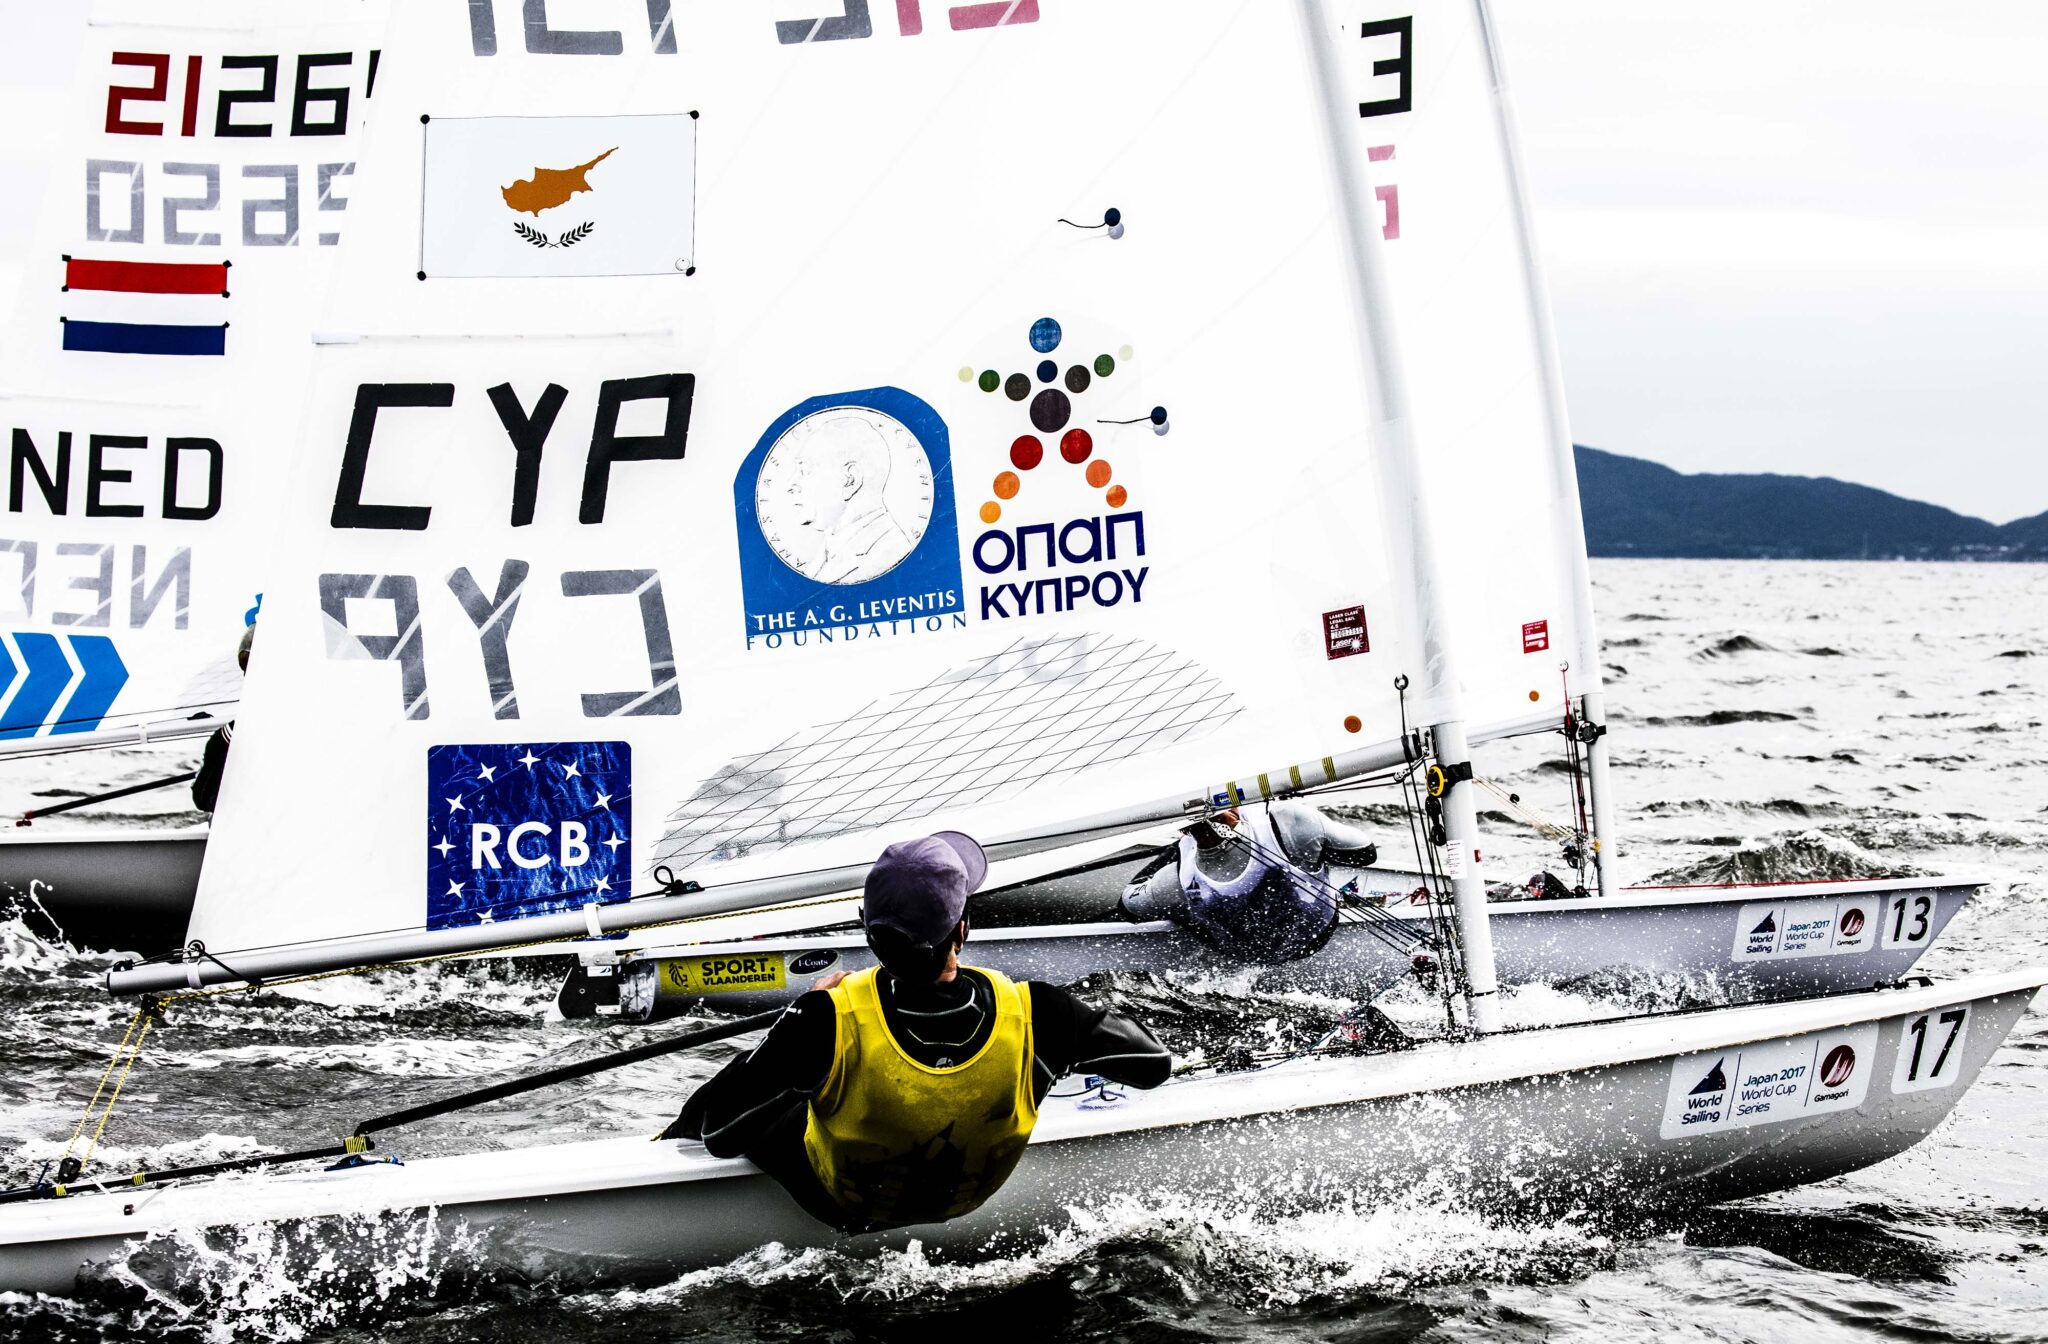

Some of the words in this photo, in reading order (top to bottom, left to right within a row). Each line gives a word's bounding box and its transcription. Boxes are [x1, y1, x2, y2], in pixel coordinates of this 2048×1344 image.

[105, 50, 381, 137] 2126
[331, 373, 695, 530] CYP
[9, 428, 223, 520] NED
[754, 611, 796, 632] THE
[804, 609, 825, 626] A.
[829, 605, 853, 622] G.
[859, 589, 957, 619] LEVENTIS
[746, 613, 967, 650] FOUNDATION
[472, 822, 589, 870] RCB
[1812, 920, 1831, 929] 2017
[1893, 896, 1932, 942] 13
[1749, 934, 1774, 944] World
[1786, 932, 1809, 941] World
[1809, 931, 1825, 941] Cup
[701, 957, 776, 977] SPORT.
[702, 973, 776, 986] VLAANDEREN
[1907, 1009, 1967, 1082] 17
[1743, 1073, 1778, 1088] Japan
[1780, 1066, 1806, 1080] 2017
[1687, 1094, 1723, 1110] World
[1741, 1086, 1775, 1101] World
[1776, 1083, 1797, 1097] Cup
[1814, 1089, 1850, 1103] Gamagori
[1681, 1110, 1721, 1125] Sailing
[1736, 1103, 1771, 1117] Series
